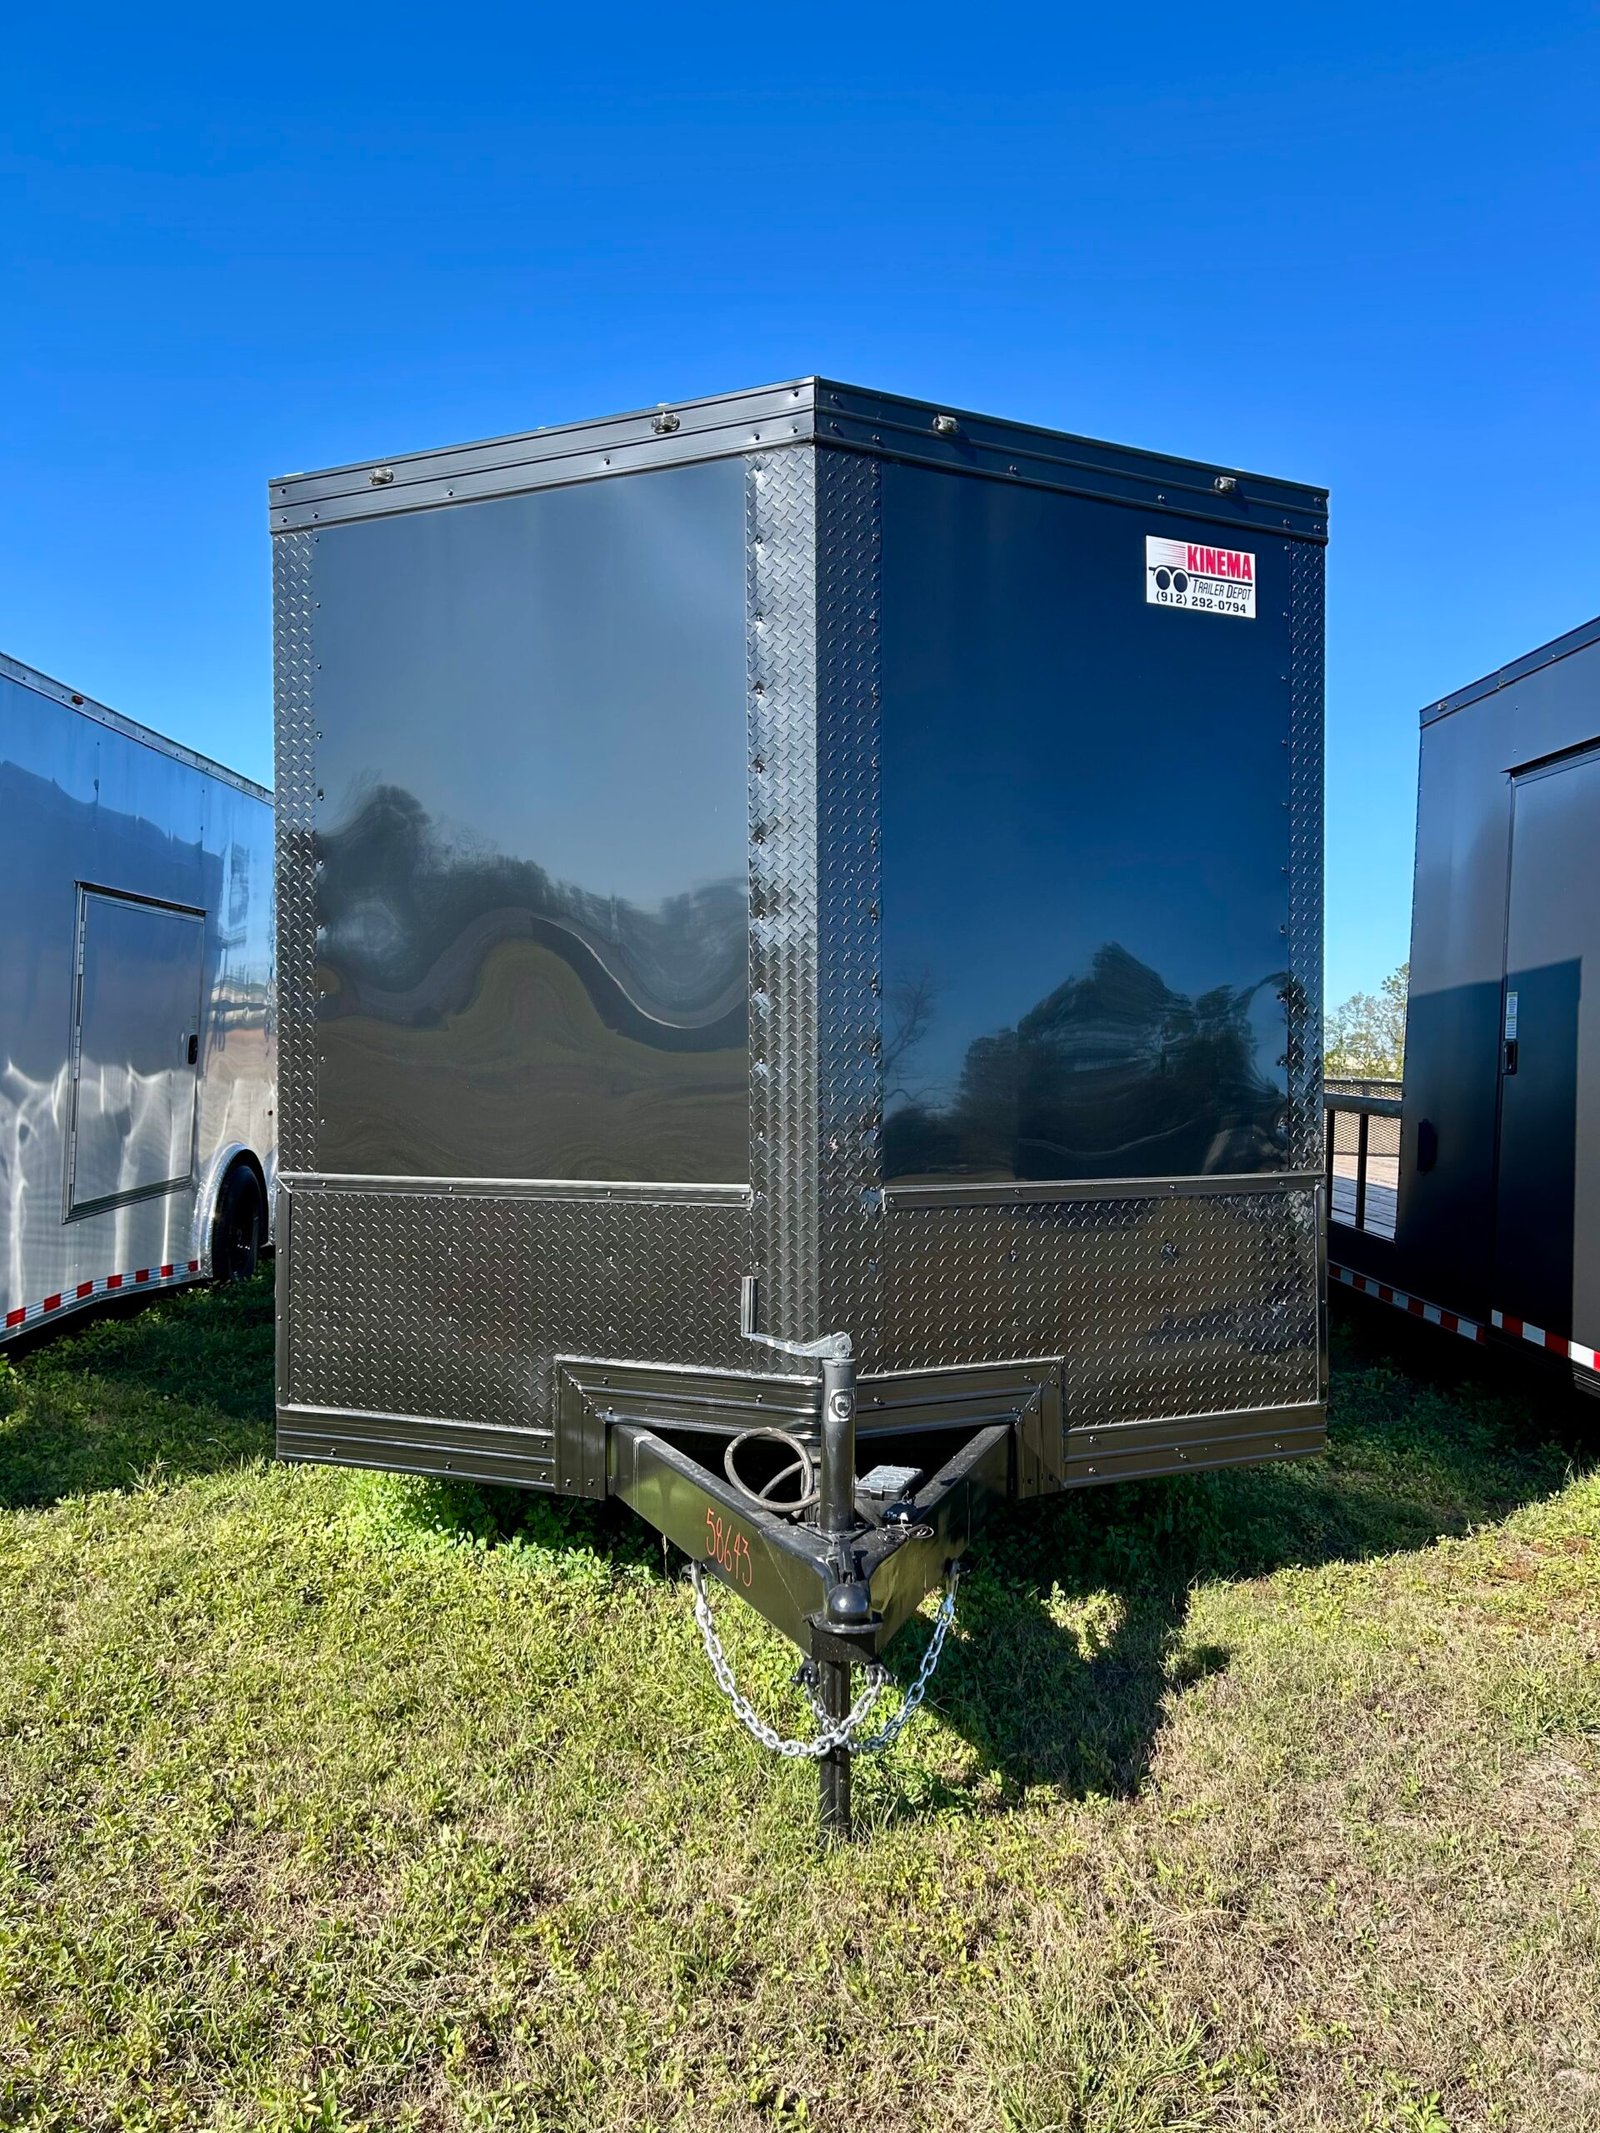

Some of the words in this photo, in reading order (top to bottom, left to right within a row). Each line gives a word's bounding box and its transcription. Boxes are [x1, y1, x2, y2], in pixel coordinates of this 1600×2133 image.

[1187, 545, 1252, 580] KINEMA
[1156, 591, 1187, 606] (912)
[1191, 596, 1246, 614] 292-0794
[706, 1507, 752, 1587] 58643
